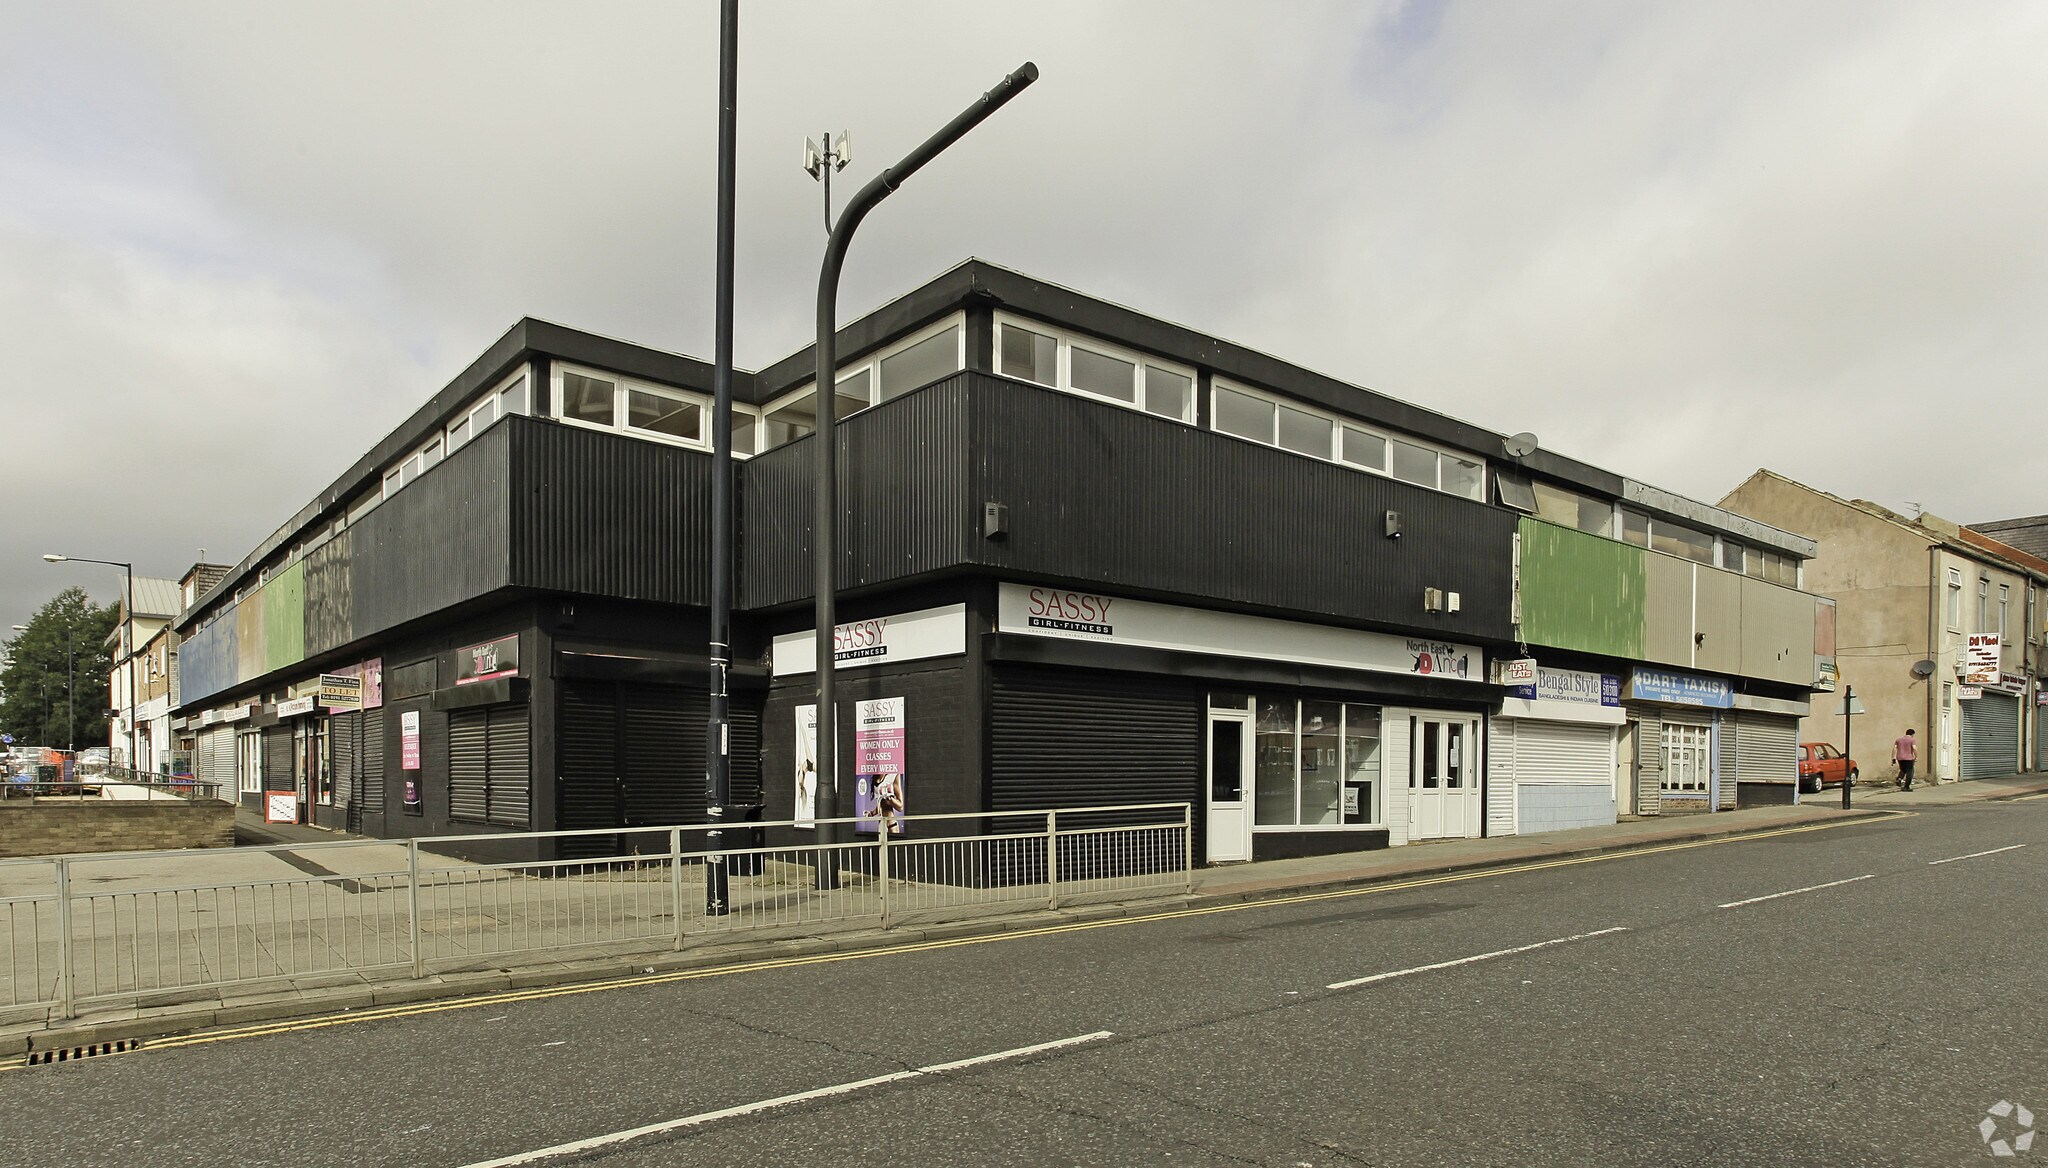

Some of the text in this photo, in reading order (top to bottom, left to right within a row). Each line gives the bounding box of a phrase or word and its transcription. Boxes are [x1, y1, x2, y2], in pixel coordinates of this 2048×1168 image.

[1029, 588, 1112, 622] SASSY
[1033, 619, 1109, 633] GIRL-FITNESS
[834, 619, 888, 651] SASSY
[1407, 640, 1446, 655] North East
[1509, 663, 1527, 672] JUST
[1512, 670, 1527, 678] EAT
[1537, 669, 1599, 697] Bengal Style
[1642, 672, 1719, 694] DART TAXIS
[339, 688, 360, 696] LET
[864, 701, 895, 718] SASSY
[860, 740, 900, 750] WOMEN ONLY
[865, 752, 892, 761] CLASSES
[860, 763, 898, 773] EVERY WEEK
